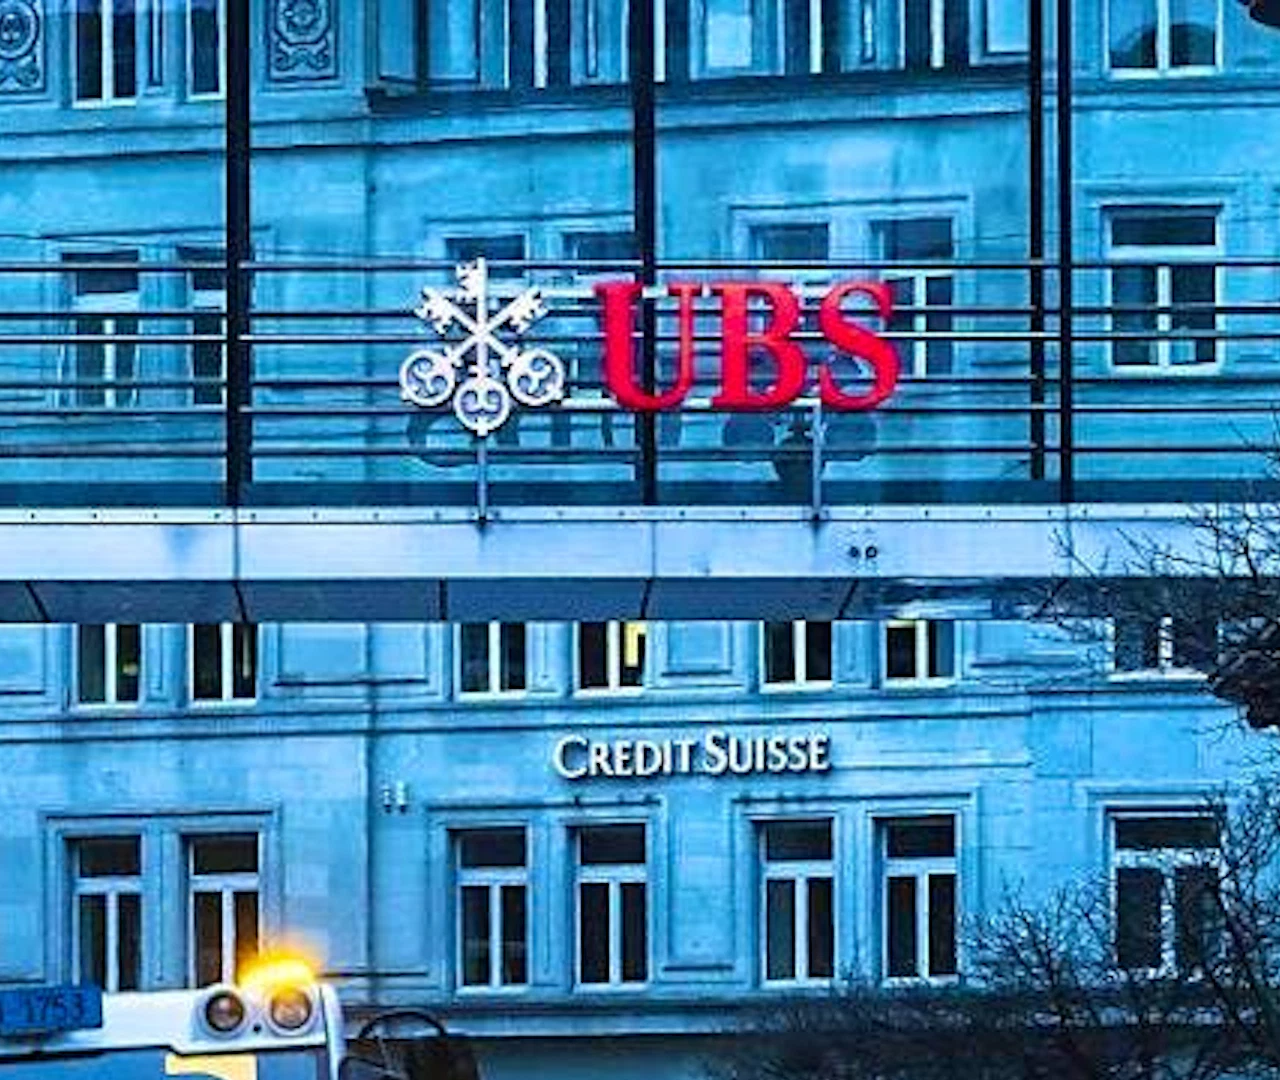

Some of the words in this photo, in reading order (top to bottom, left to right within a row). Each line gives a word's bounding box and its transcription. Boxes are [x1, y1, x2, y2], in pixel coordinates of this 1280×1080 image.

[593, 281, 900, 411] UBS
[553, 734, 696, 779] CREDIT
[704, 729, 830, 774] SUISSE
